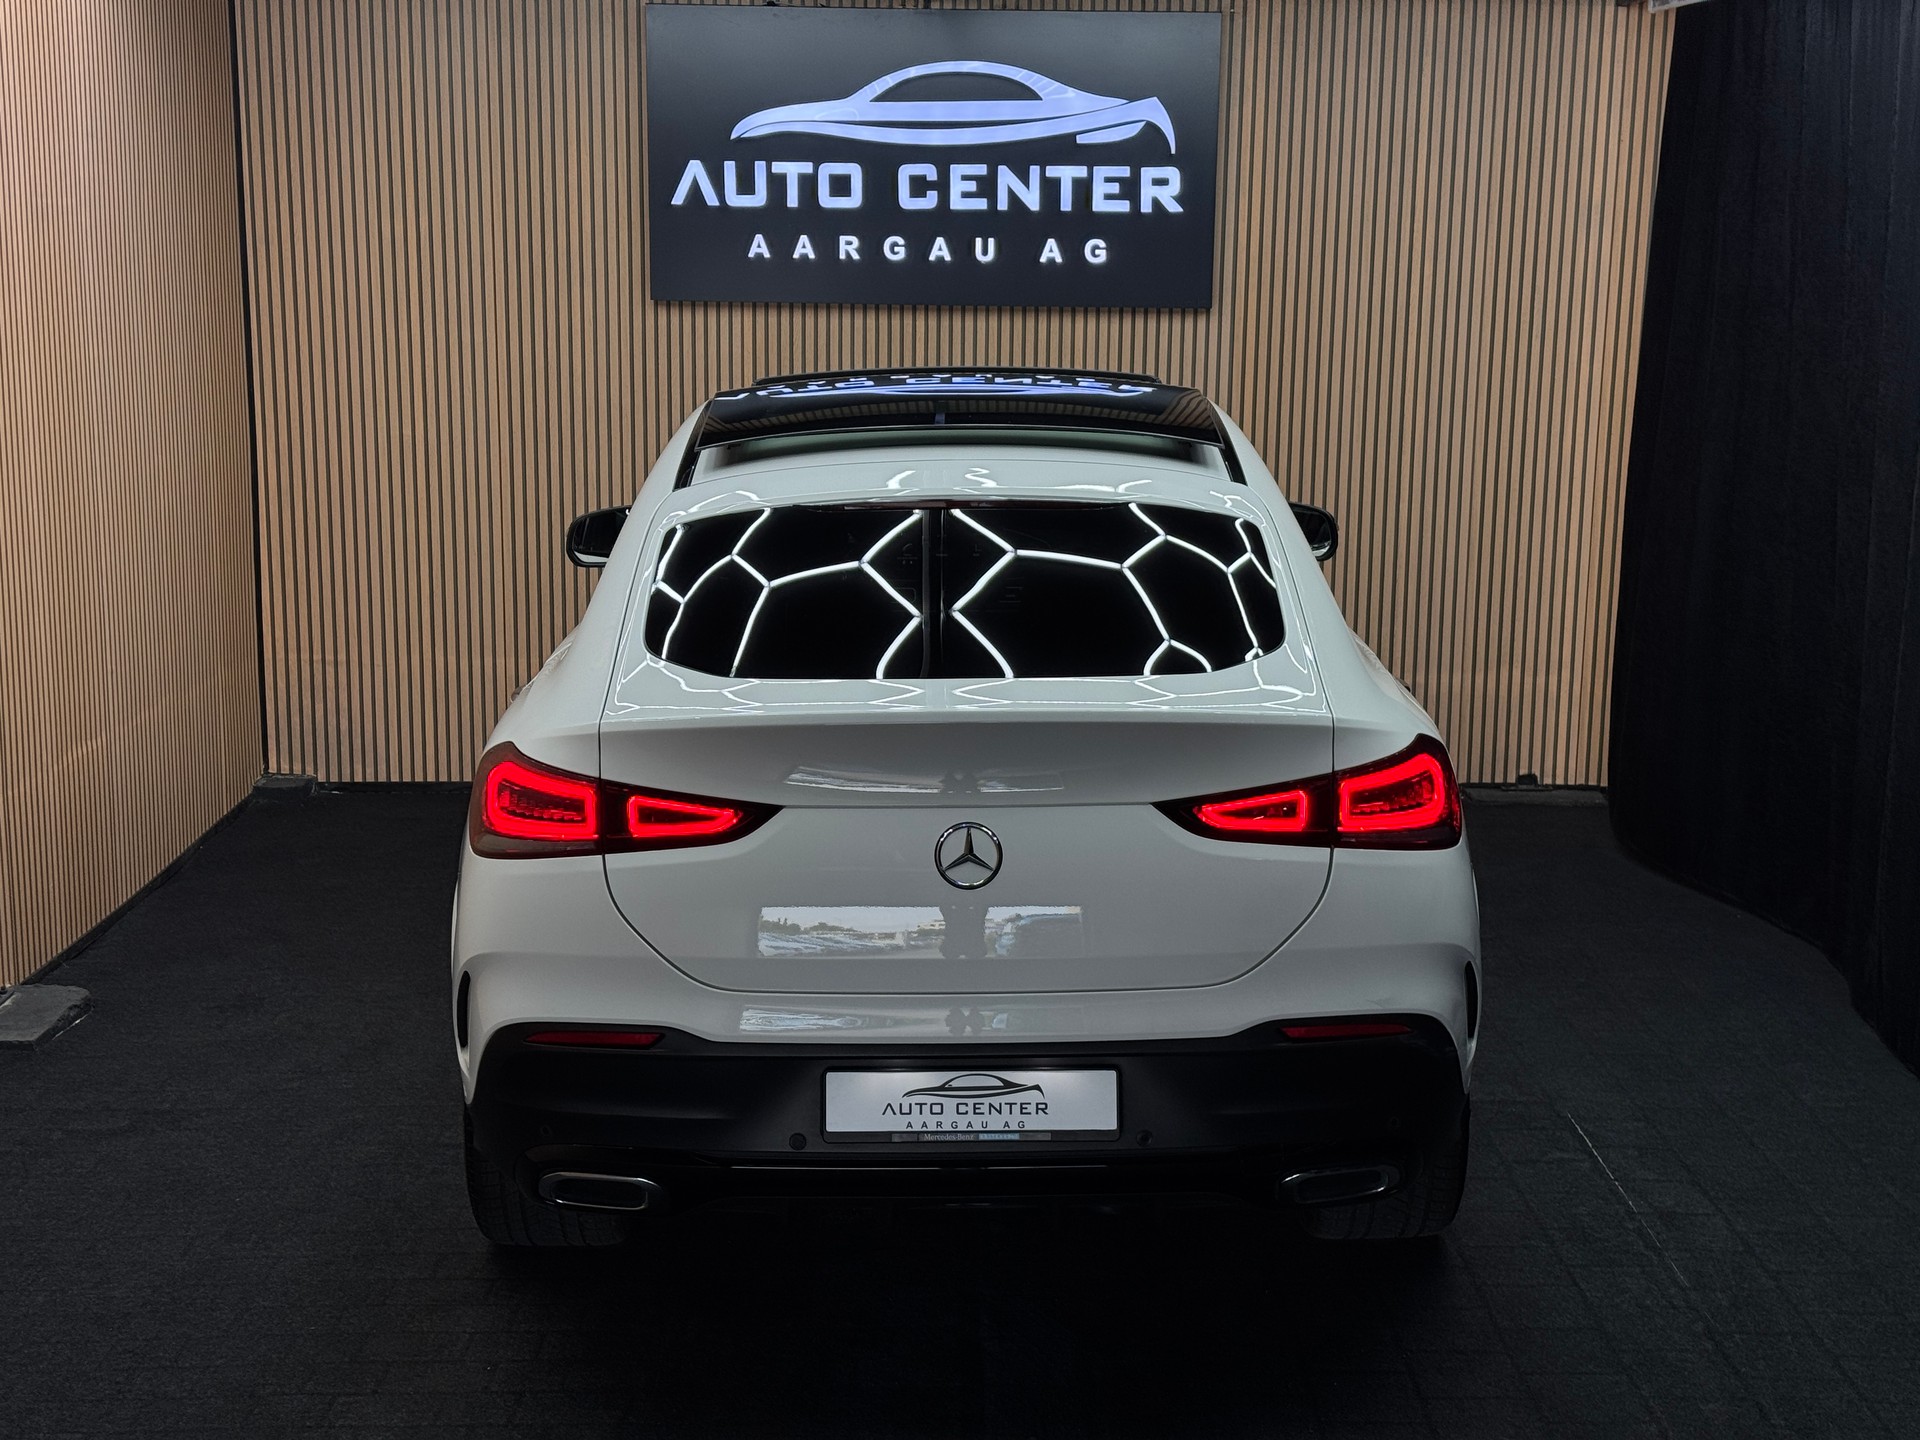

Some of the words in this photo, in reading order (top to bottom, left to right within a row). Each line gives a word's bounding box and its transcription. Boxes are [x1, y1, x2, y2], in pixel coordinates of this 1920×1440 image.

[671, 160, 863, 208] AUTO
[898, 163, 1184, 213] CENTER
[747, 233, 995, 264] AARGAU
[1039, 239, 1107, 264] AG
[882, 1102, 944, 1115] AUTO
[956, 1102, 1048, 1115] CENTER
[905, 1121, 988, 1129] AARGAU
[1002, 1120, 1026, 1129] AG
